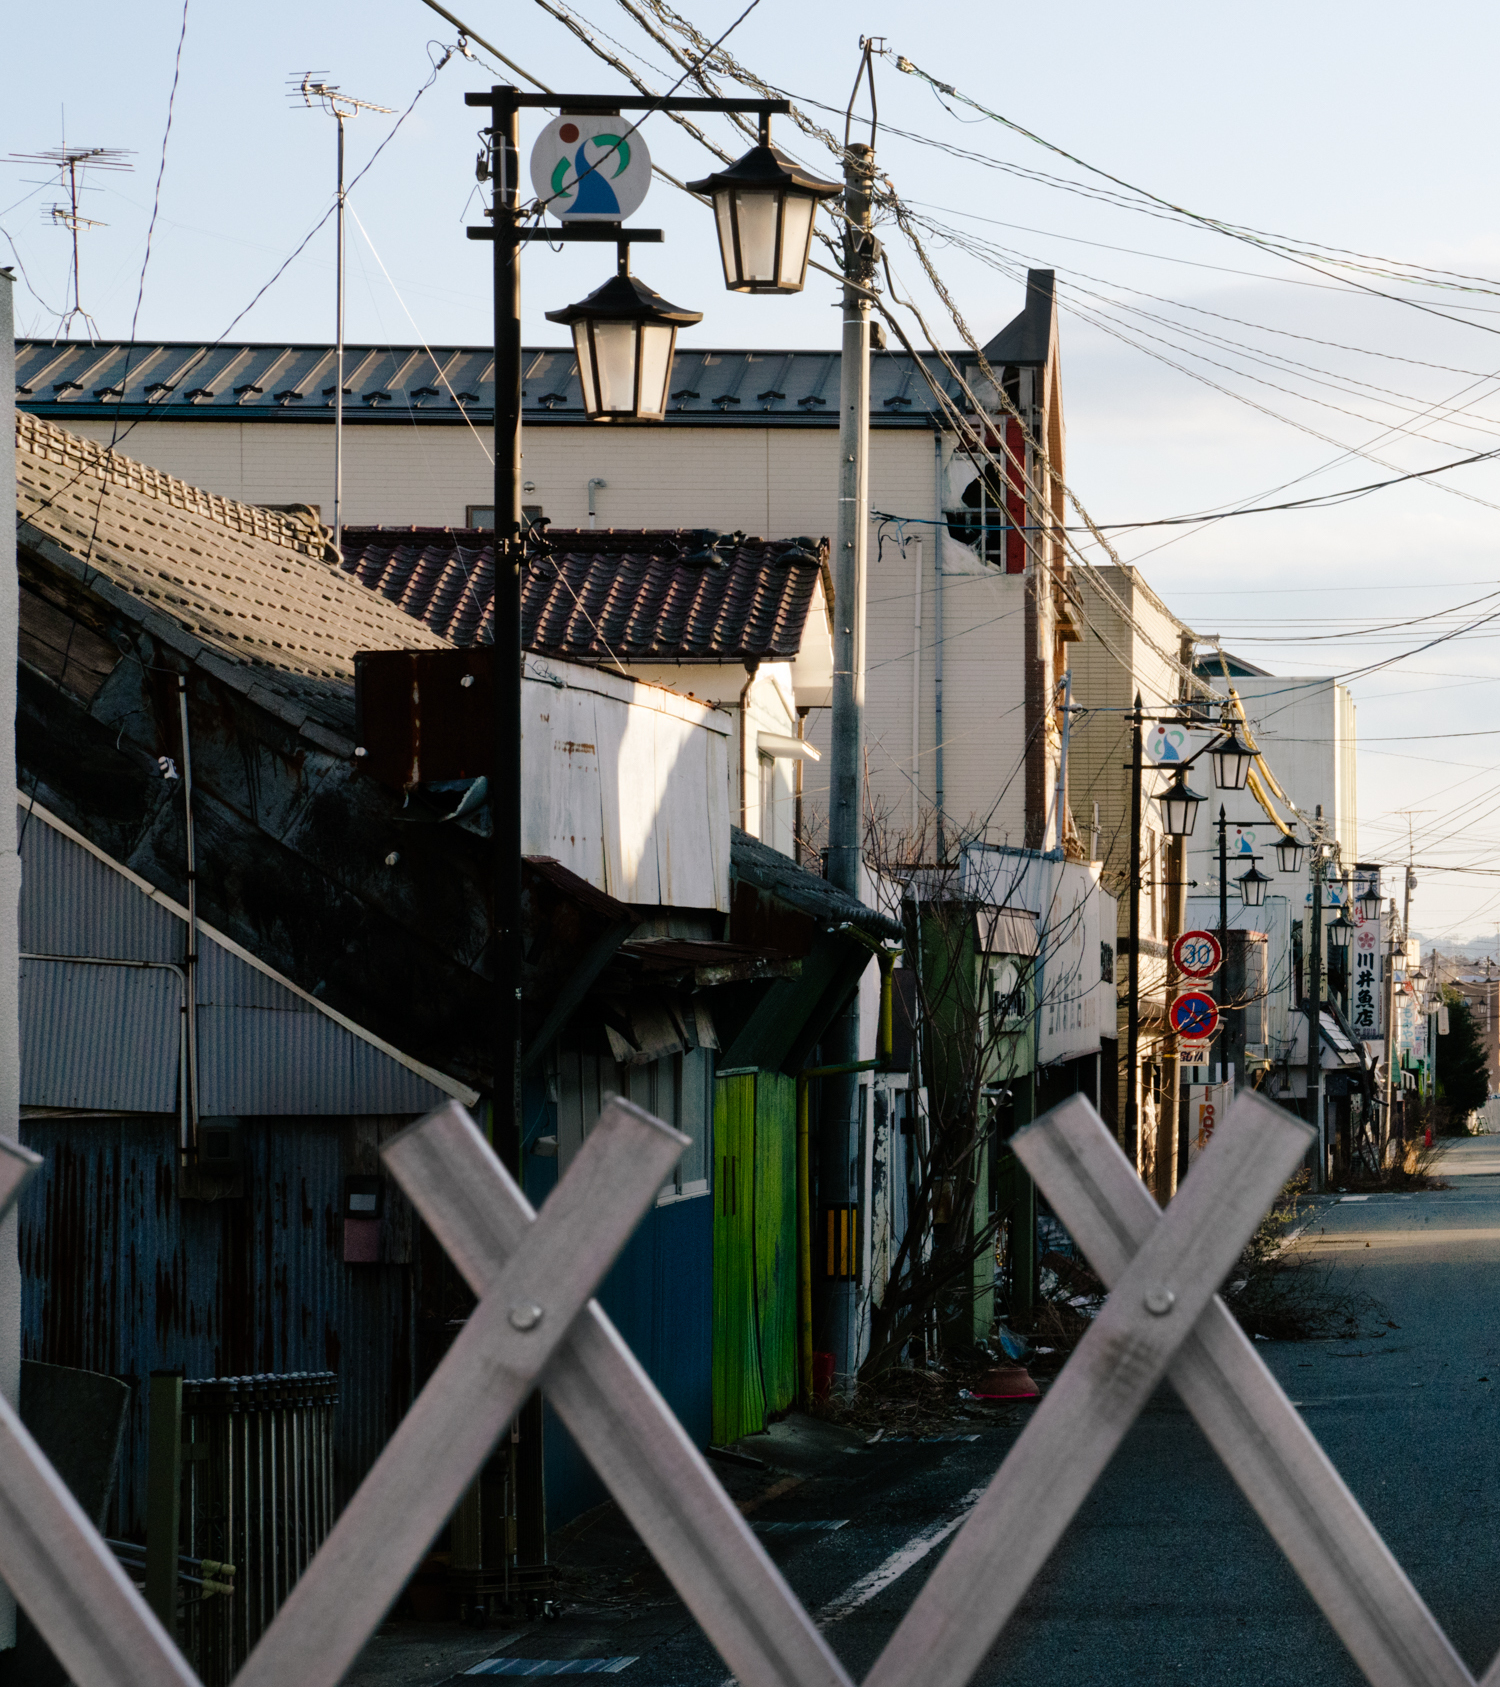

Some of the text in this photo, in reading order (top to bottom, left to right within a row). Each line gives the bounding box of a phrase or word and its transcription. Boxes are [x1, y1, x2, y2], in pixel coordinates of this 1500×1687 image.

[1185, 944, 1210, 964] 30
[1354, 952, 1375, 1027] 川井魚店
